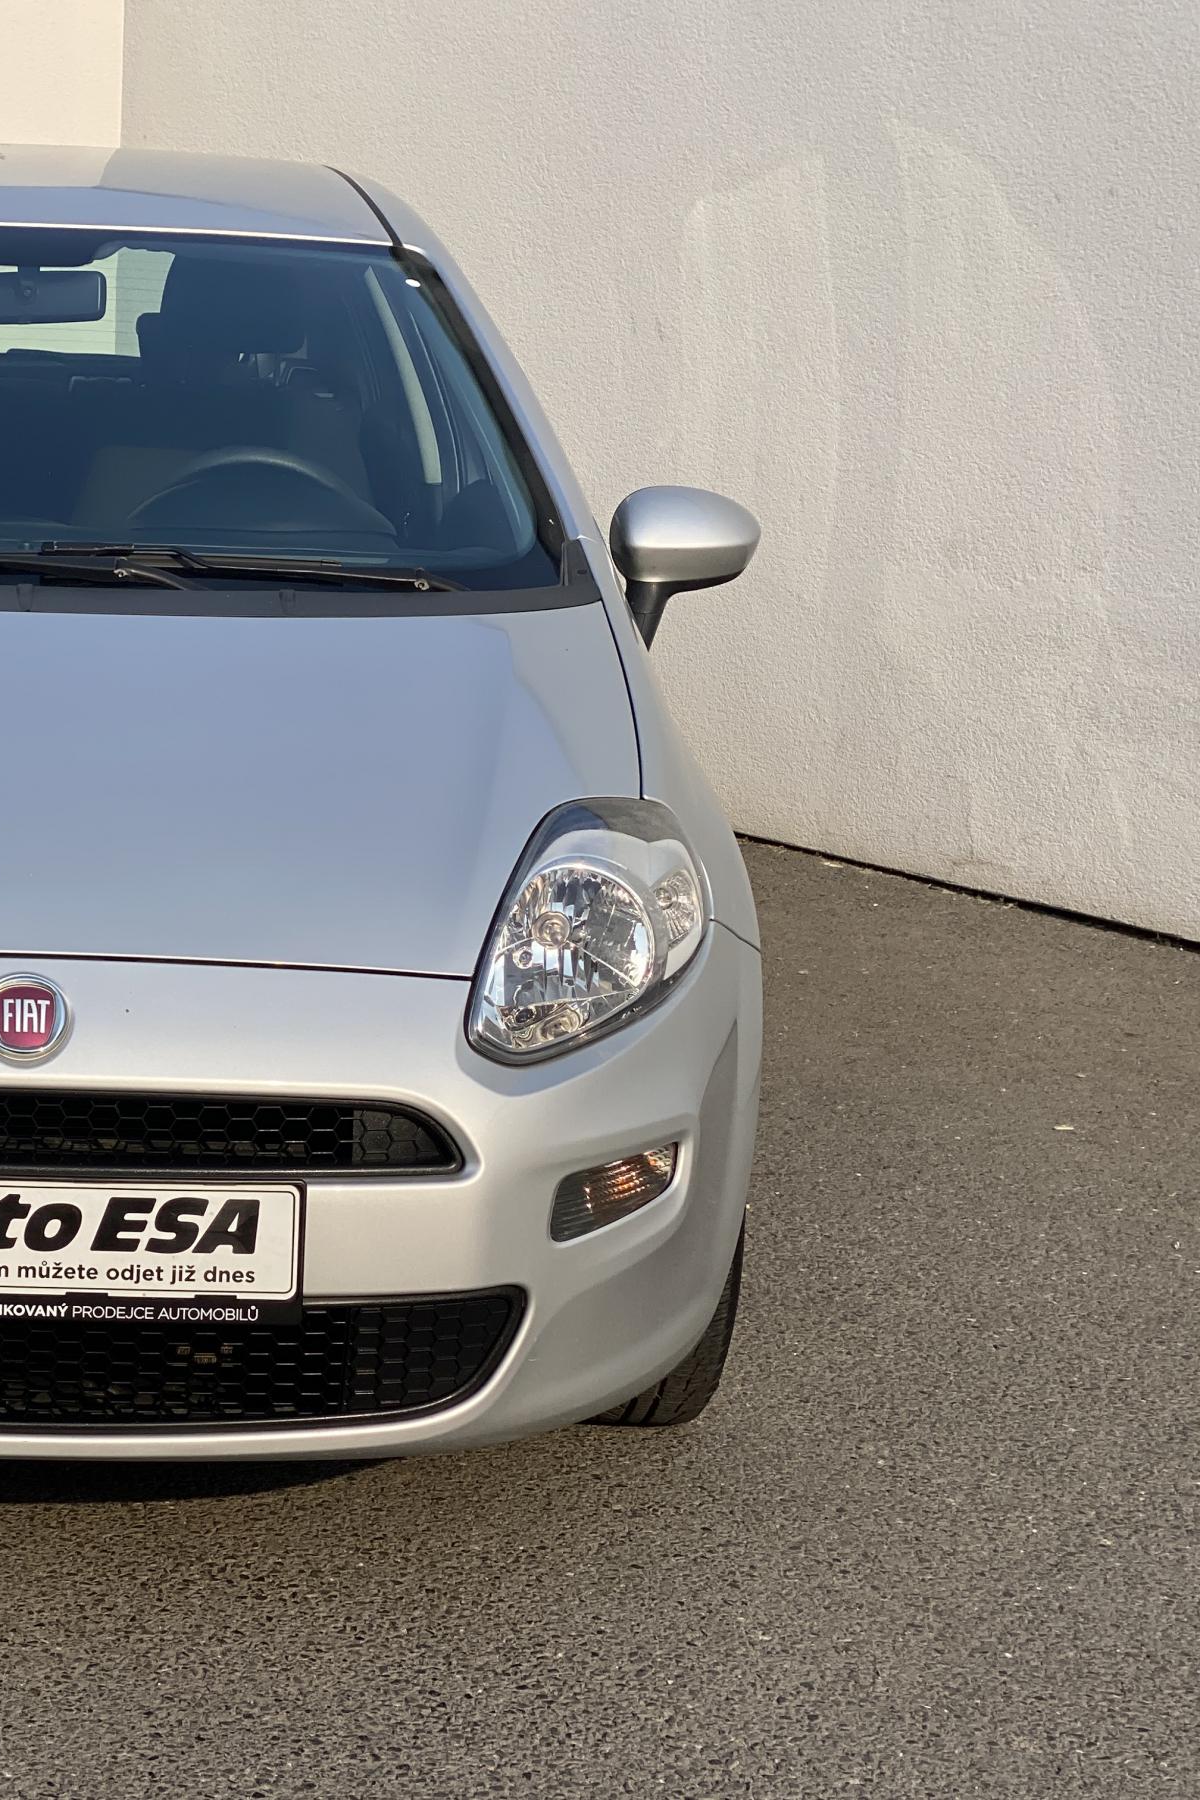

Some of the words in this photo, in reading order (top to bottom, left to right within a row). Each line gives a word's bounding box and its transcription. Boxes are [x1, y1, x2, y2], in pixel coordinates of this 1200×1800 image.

[3, 998, 51, 1034] FIAT
[89, 1196, 261, 1255] ESA
[16, 1260, 99, 1281] můžete
[106, 1264, 164, 1285] odjet
[169, 1265, 196, 1286] již
[203, 1265, 256, 1284] dnes
[71, 1304, 155, 1320] PRODEJCE
[156, 1305, 260, 1322] AUTOMOBILŮ
